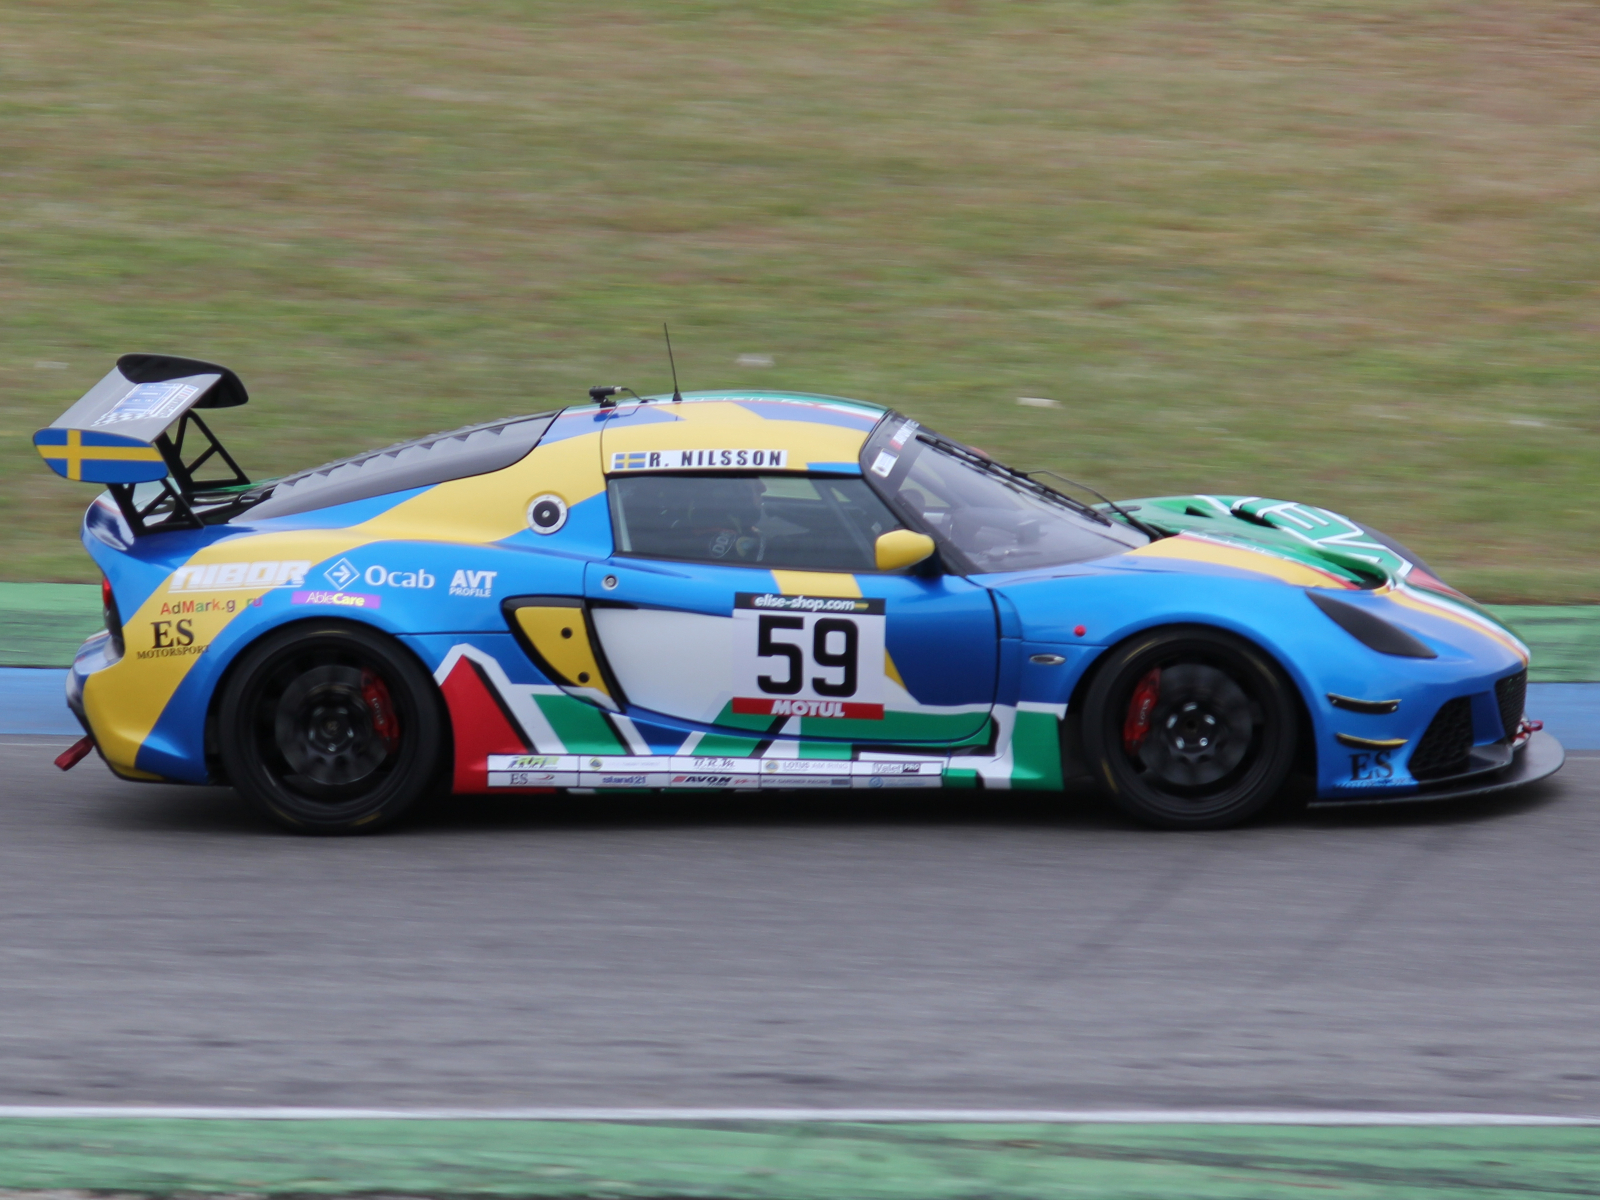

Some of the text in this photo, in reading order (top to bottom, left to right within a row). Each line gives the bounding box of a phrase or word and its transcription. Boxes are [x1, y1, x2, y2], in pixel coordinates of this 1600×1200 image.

[649, 449, 783, 468] R. NILSSON
[169, 559, 312, 591] NIBOR
[364, 564, 436, 590] Ocab
[450, 569, 498, 588] AVT
[305, 591, 366, 607] AbleCare
[448, 586, 492, 598] PROFILE
[160, 597, 263, 615] AdMark.gru
[753, 592, 856, 612] elise-shop.com
[150, 618, 195, 649] ES
[136, 644, 211, 660] MOTORSPORT
[757, 614, 858, 698] 59
[770, 700, 846, 718] MOTUL
[1349, 750, 1393, 781] ES
[685, 776, 733, 784] AVON
